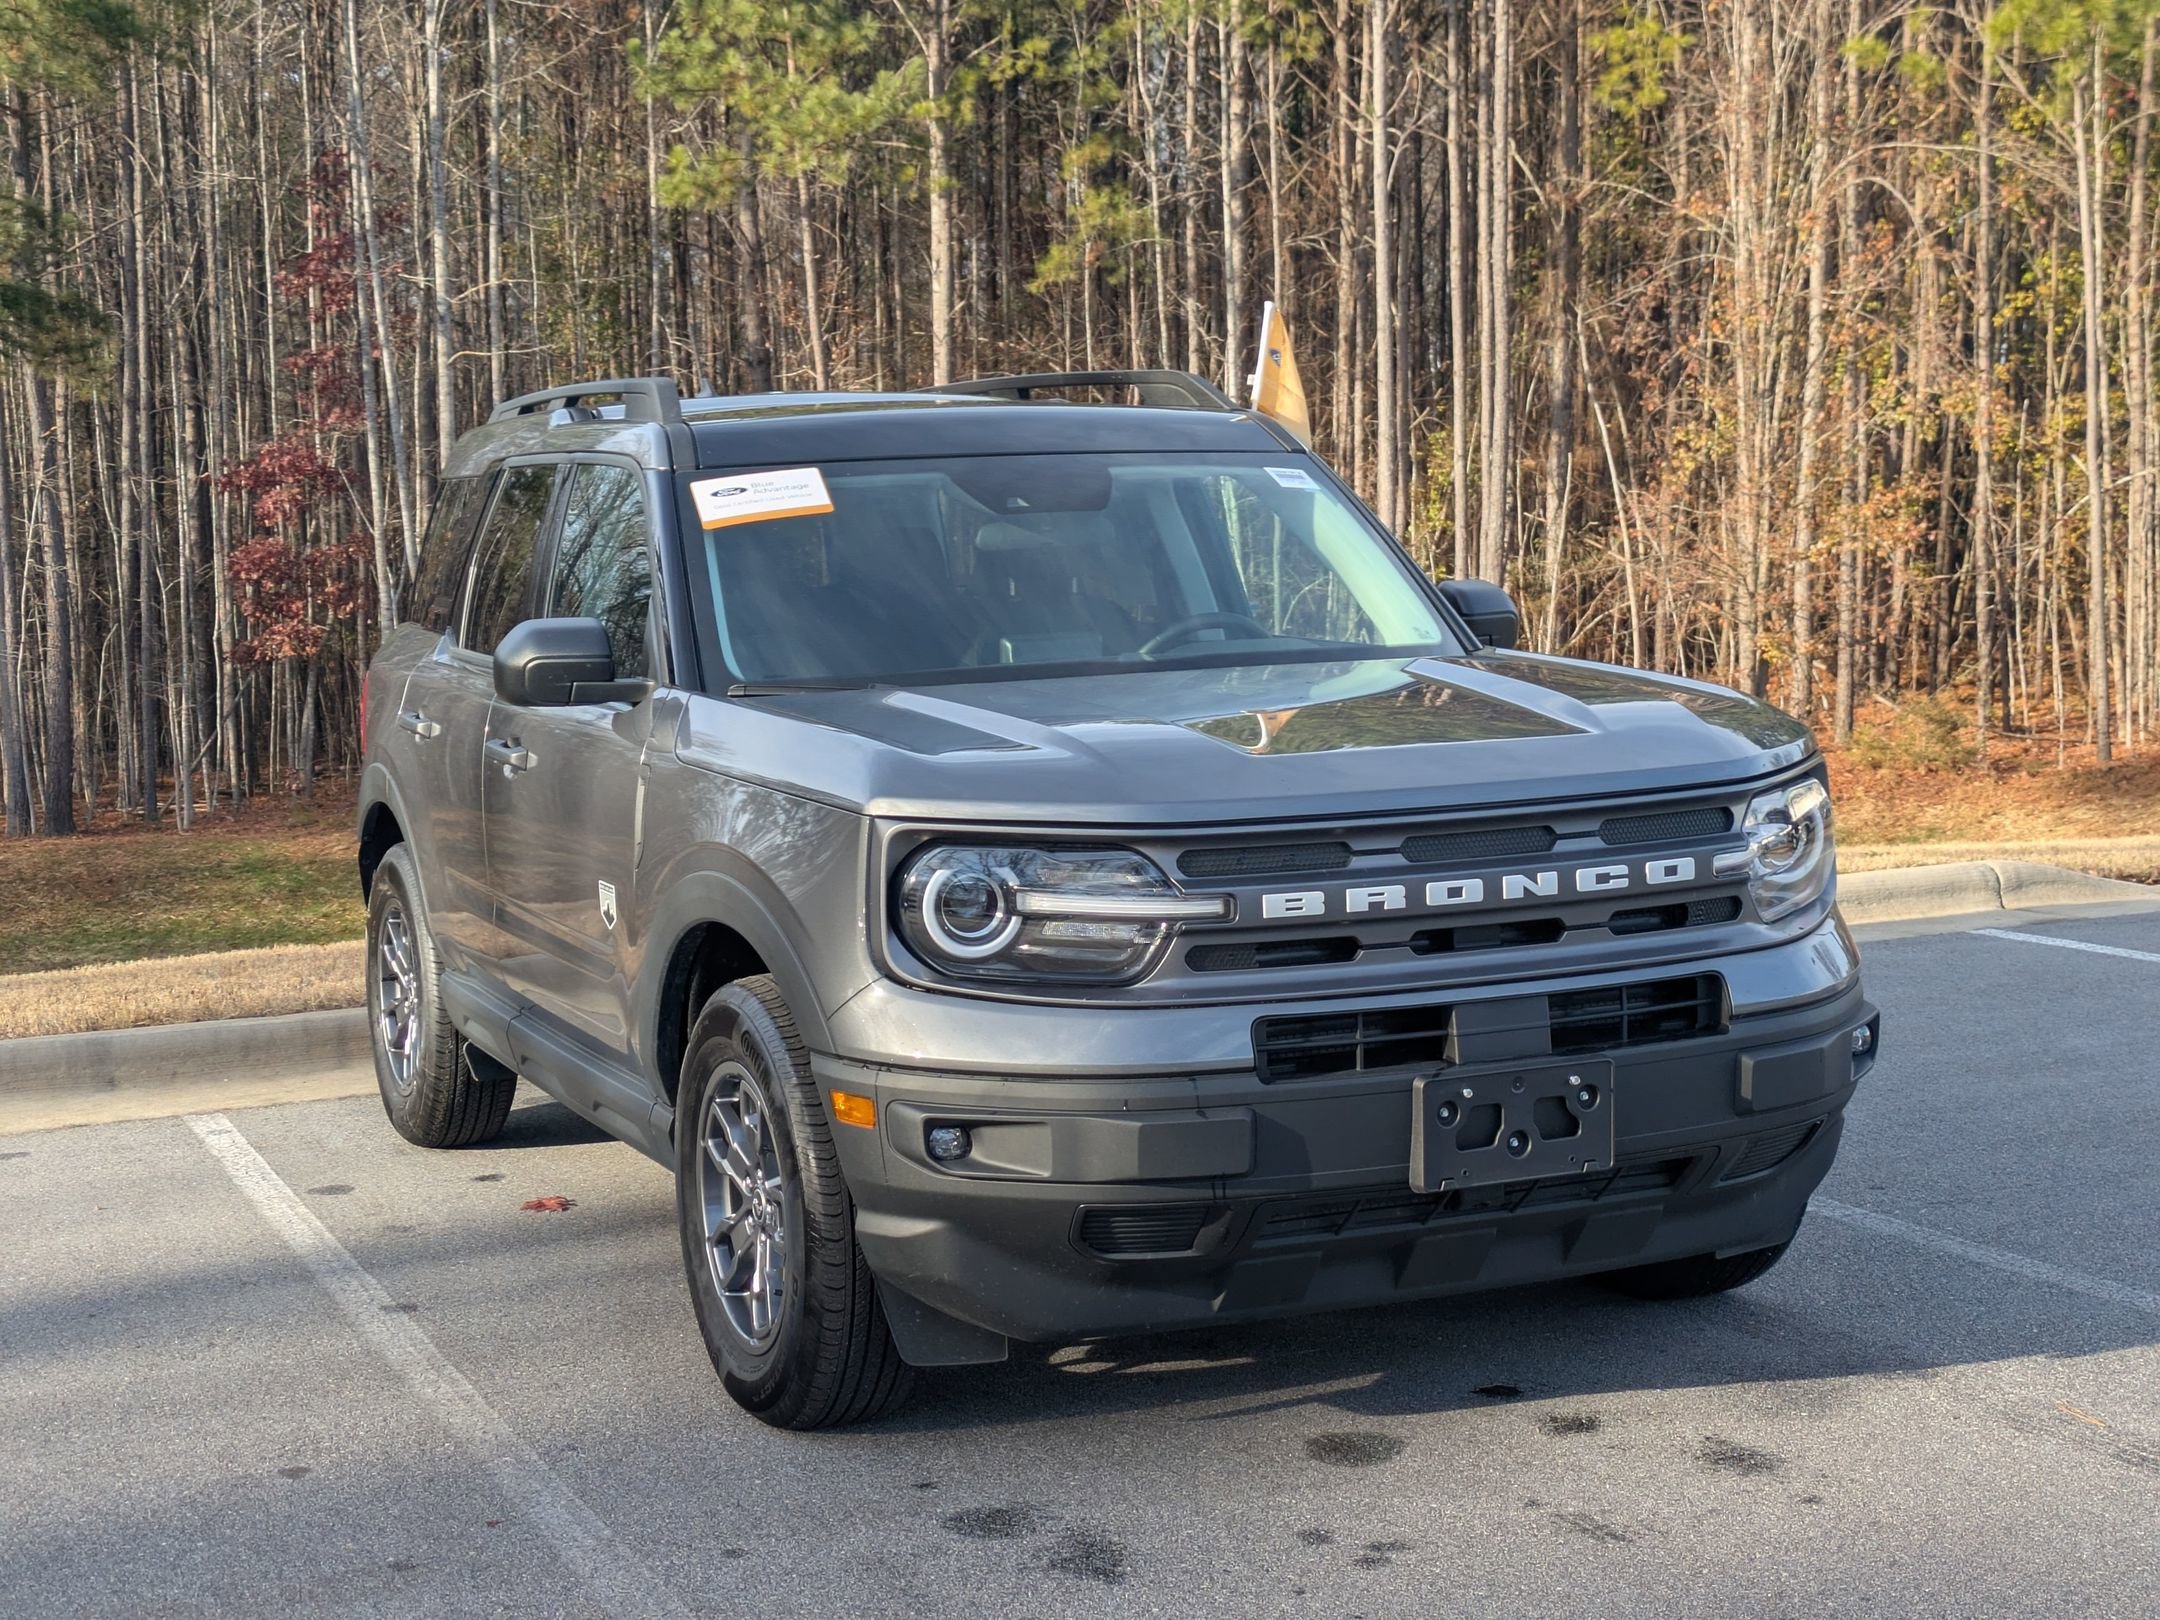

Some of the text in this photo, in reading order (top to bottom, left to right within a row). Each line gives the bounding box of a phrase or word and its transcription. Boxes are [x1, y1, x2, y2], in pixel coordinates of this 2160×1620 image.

[751, 481, 774, 489] Blue
[752, 483, 809, 495] Advantage
[1262, 857, 1696, 919] BRONCO
